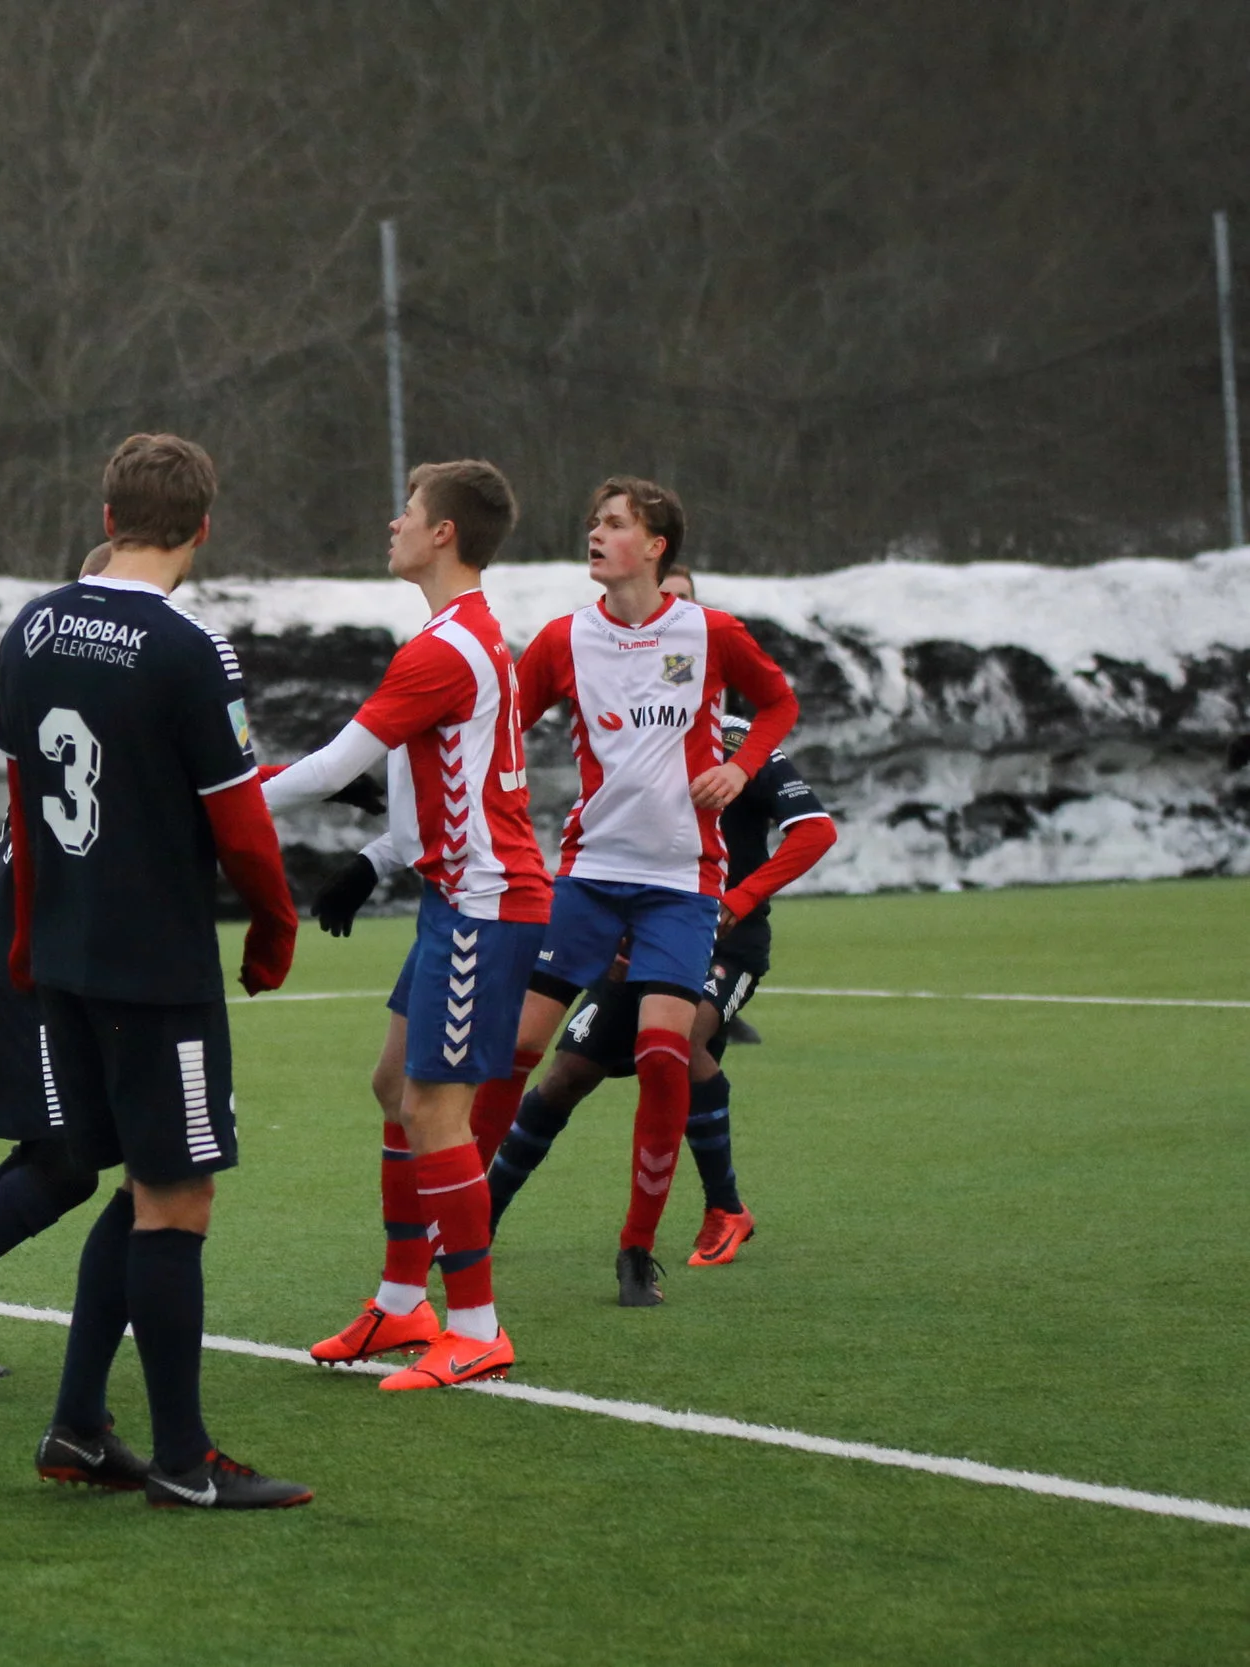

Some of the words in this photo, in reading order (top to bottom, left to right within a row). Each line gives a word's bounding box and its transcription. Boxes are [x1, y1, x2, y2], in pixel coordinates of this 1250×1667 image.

[57, 615, 147, 650] DRØBAK
[618, 637, 659, 651] hummel
[52, 637, 139, 669] ELEKTRISKE
[629, 705, 688, 729] VISMA
[38, 707, 100, 857] 3
[567, 1003, 598, 1043] 4
